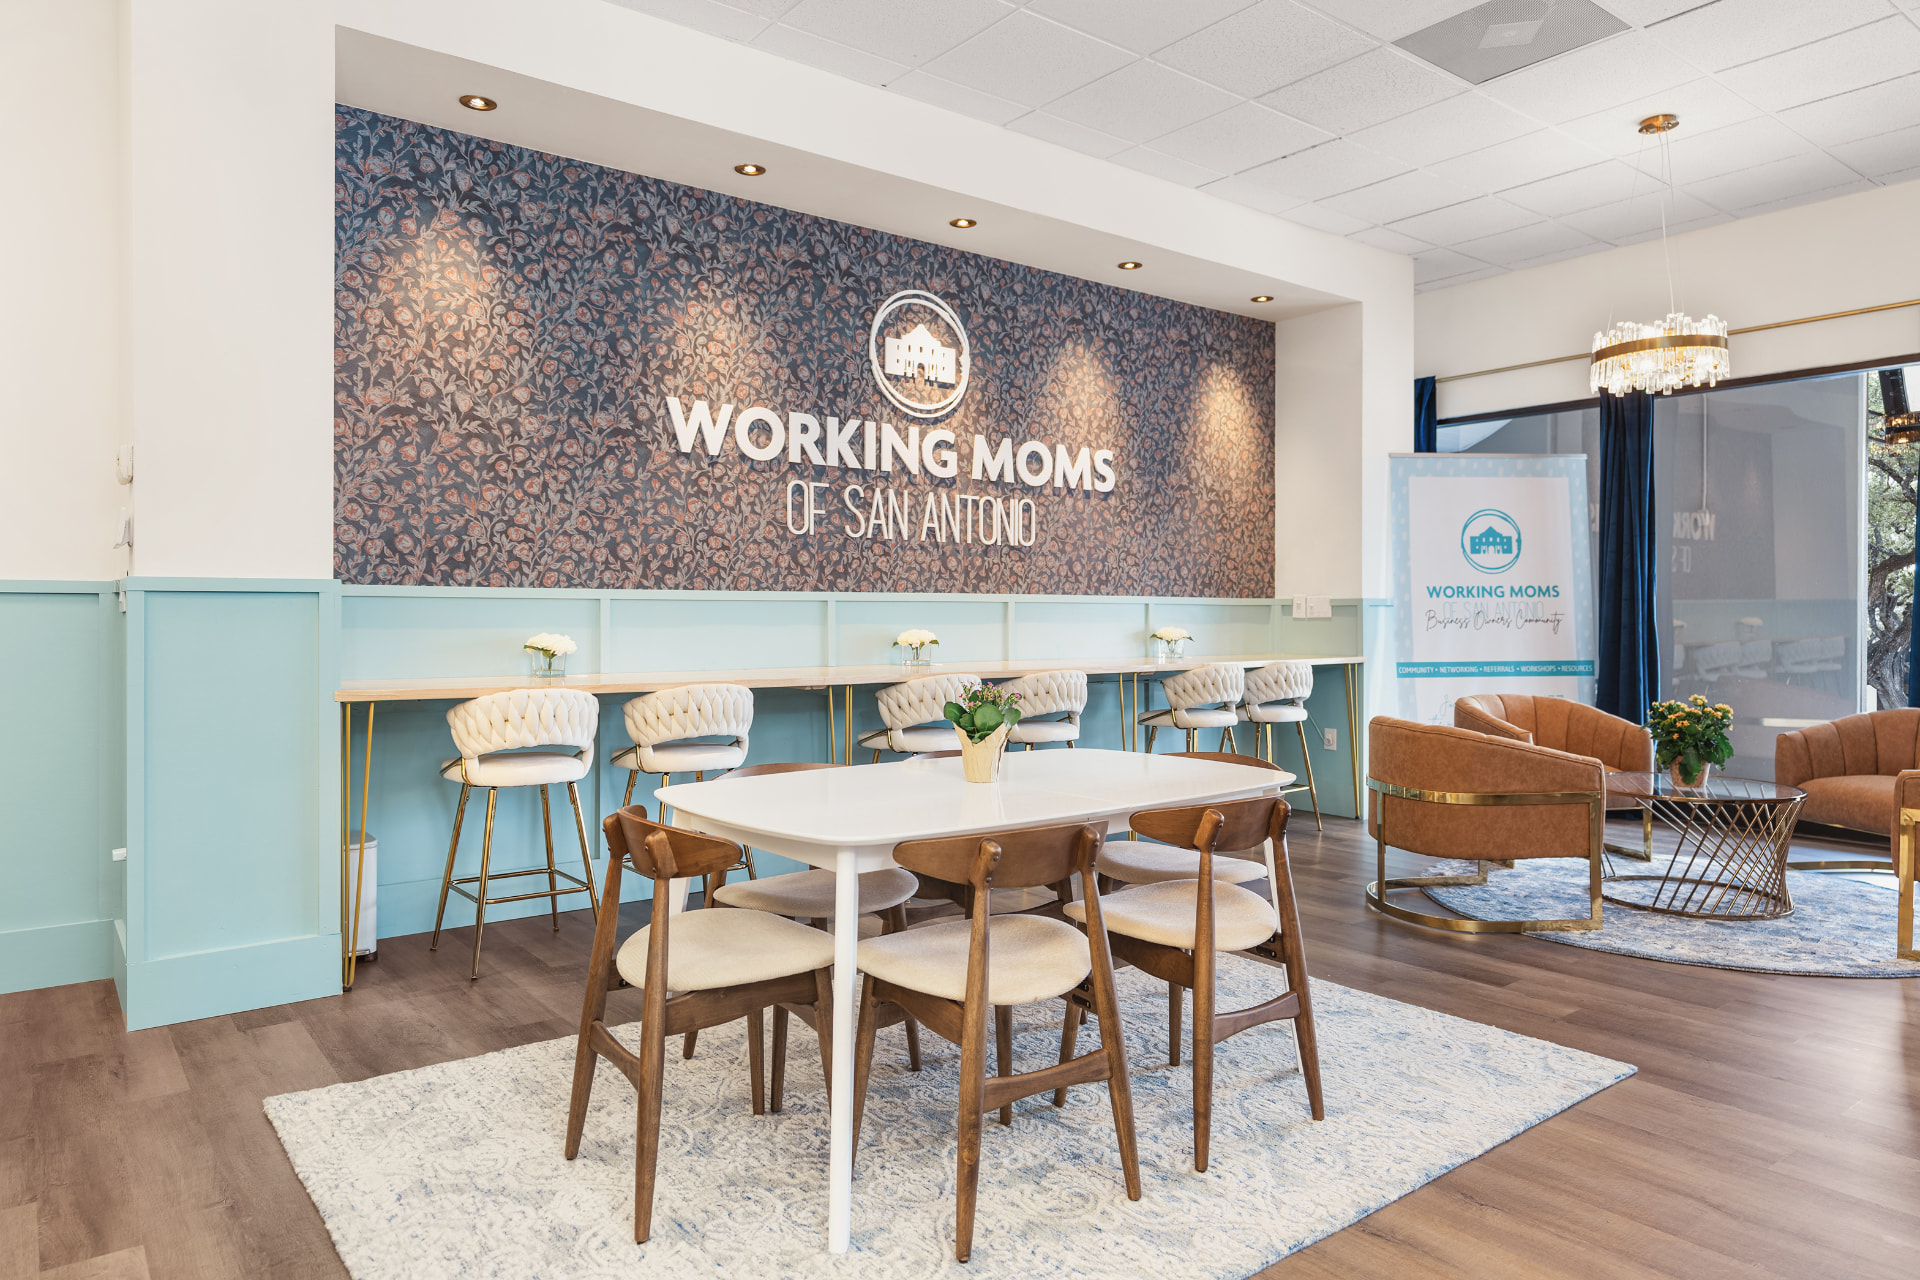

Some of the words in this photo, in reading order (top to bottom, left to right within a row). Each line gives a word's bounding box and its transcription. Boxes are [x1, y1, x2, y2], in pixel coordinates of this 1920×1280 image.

[665, 396, 958, 479] WORKING
[971, 434, 1116, 493] MOMS
[786, 479, 830, 536] OF
[844, 483, 909, 541] SAN
[921, 492, 1037, 547] ANTONIO
[1426, 585, 1505, 599] WORKING
[1509, 585, 1560, 598] MOMS
[1425, 608, 1471, 632] Business
[1473, 609, 1513, 631] Owners
[1515, 608, 1565, 635] Community
[1463, 601, 1489, 621] SAN
[1398, 666, 1434, 674] COMMUNITY
[1439, 665, 1479, 673] NETWORKING
[1483, 665, 1515, 673] REFERRALS
[1520, 664, 1557, 672] WORKSHOPS
[1561, 664, 1593, 672] RESOURCES
